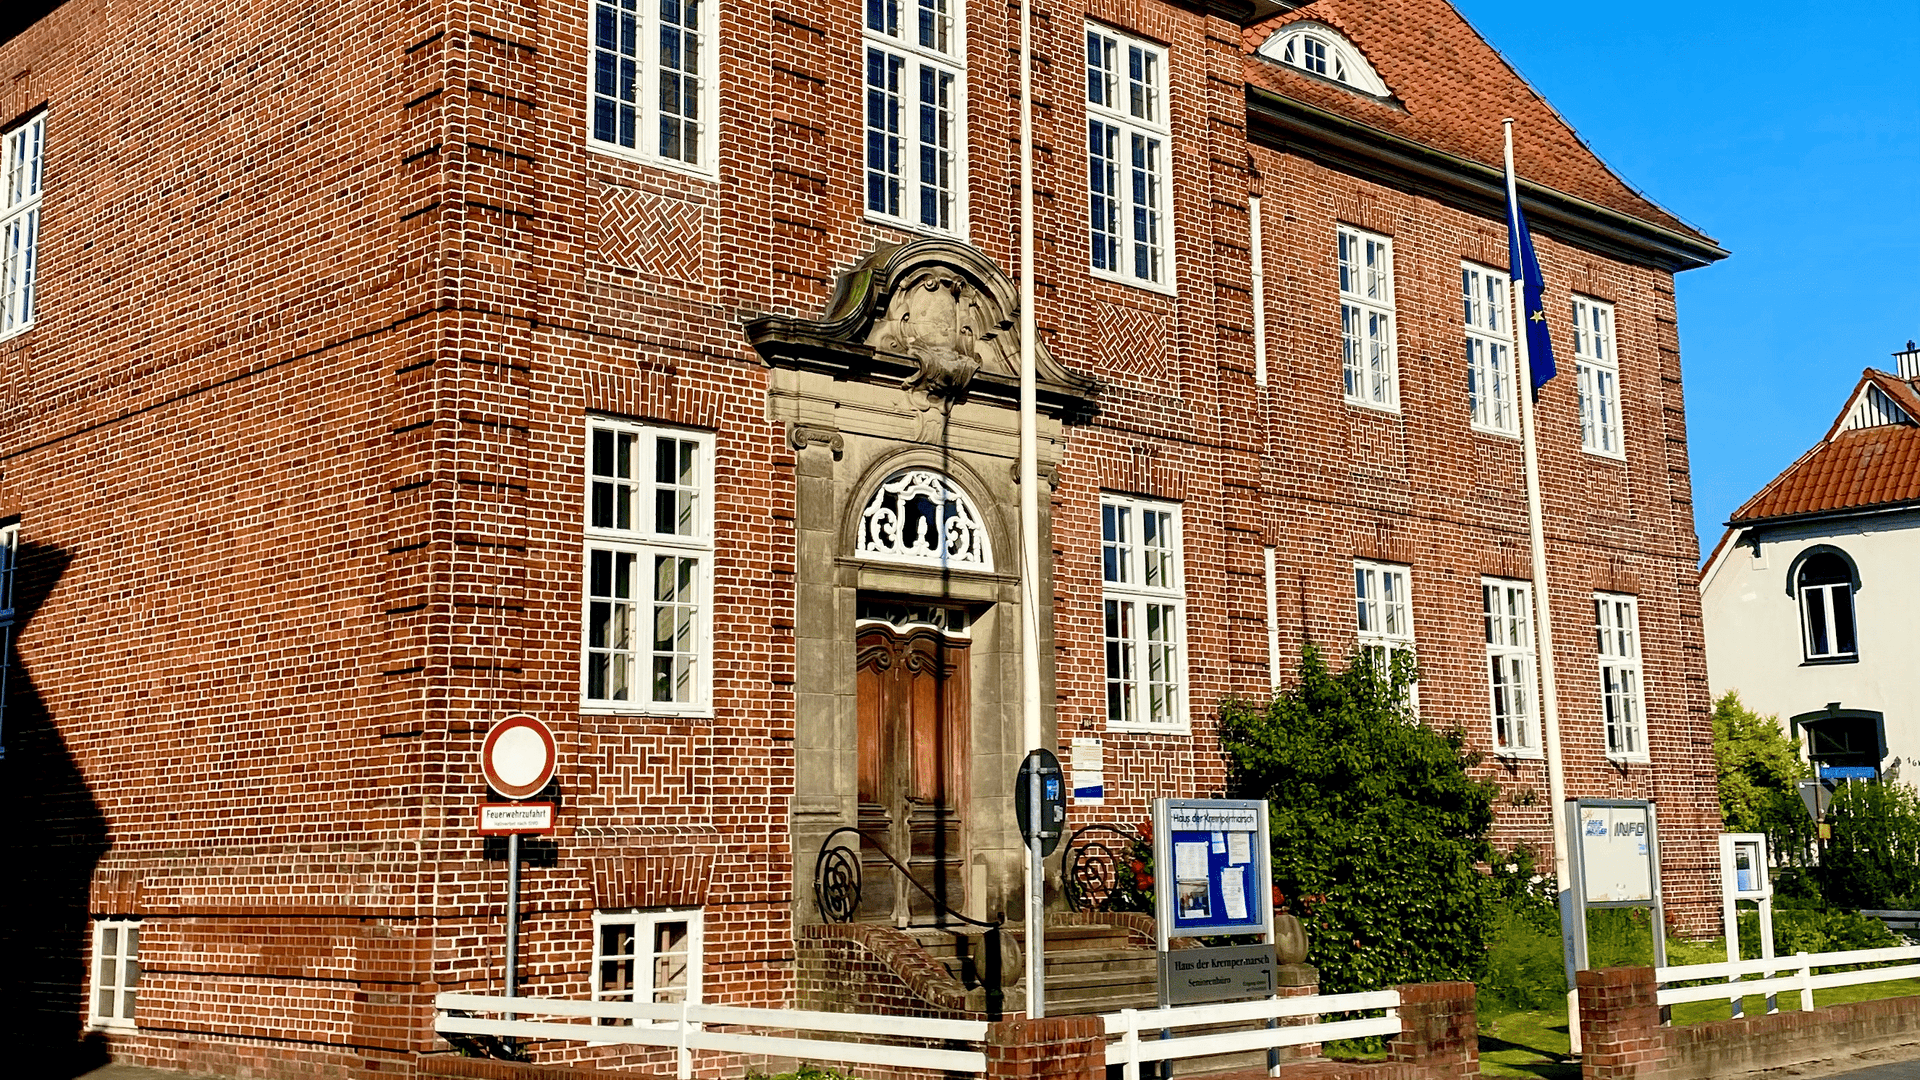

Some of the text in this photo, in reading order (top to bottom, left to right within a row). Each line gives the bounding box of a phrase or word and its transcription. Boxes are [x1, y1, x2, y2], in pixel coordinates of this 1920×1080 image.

[486, 809, 546, 819] Feuerwehrzufahrt
[1173, 813, 1255, 824] Haus der Krempermarsch
[1614, 822, 1645, 836] INFO
[1174, 955, 1270, 971] Haus der Krempermarsch
